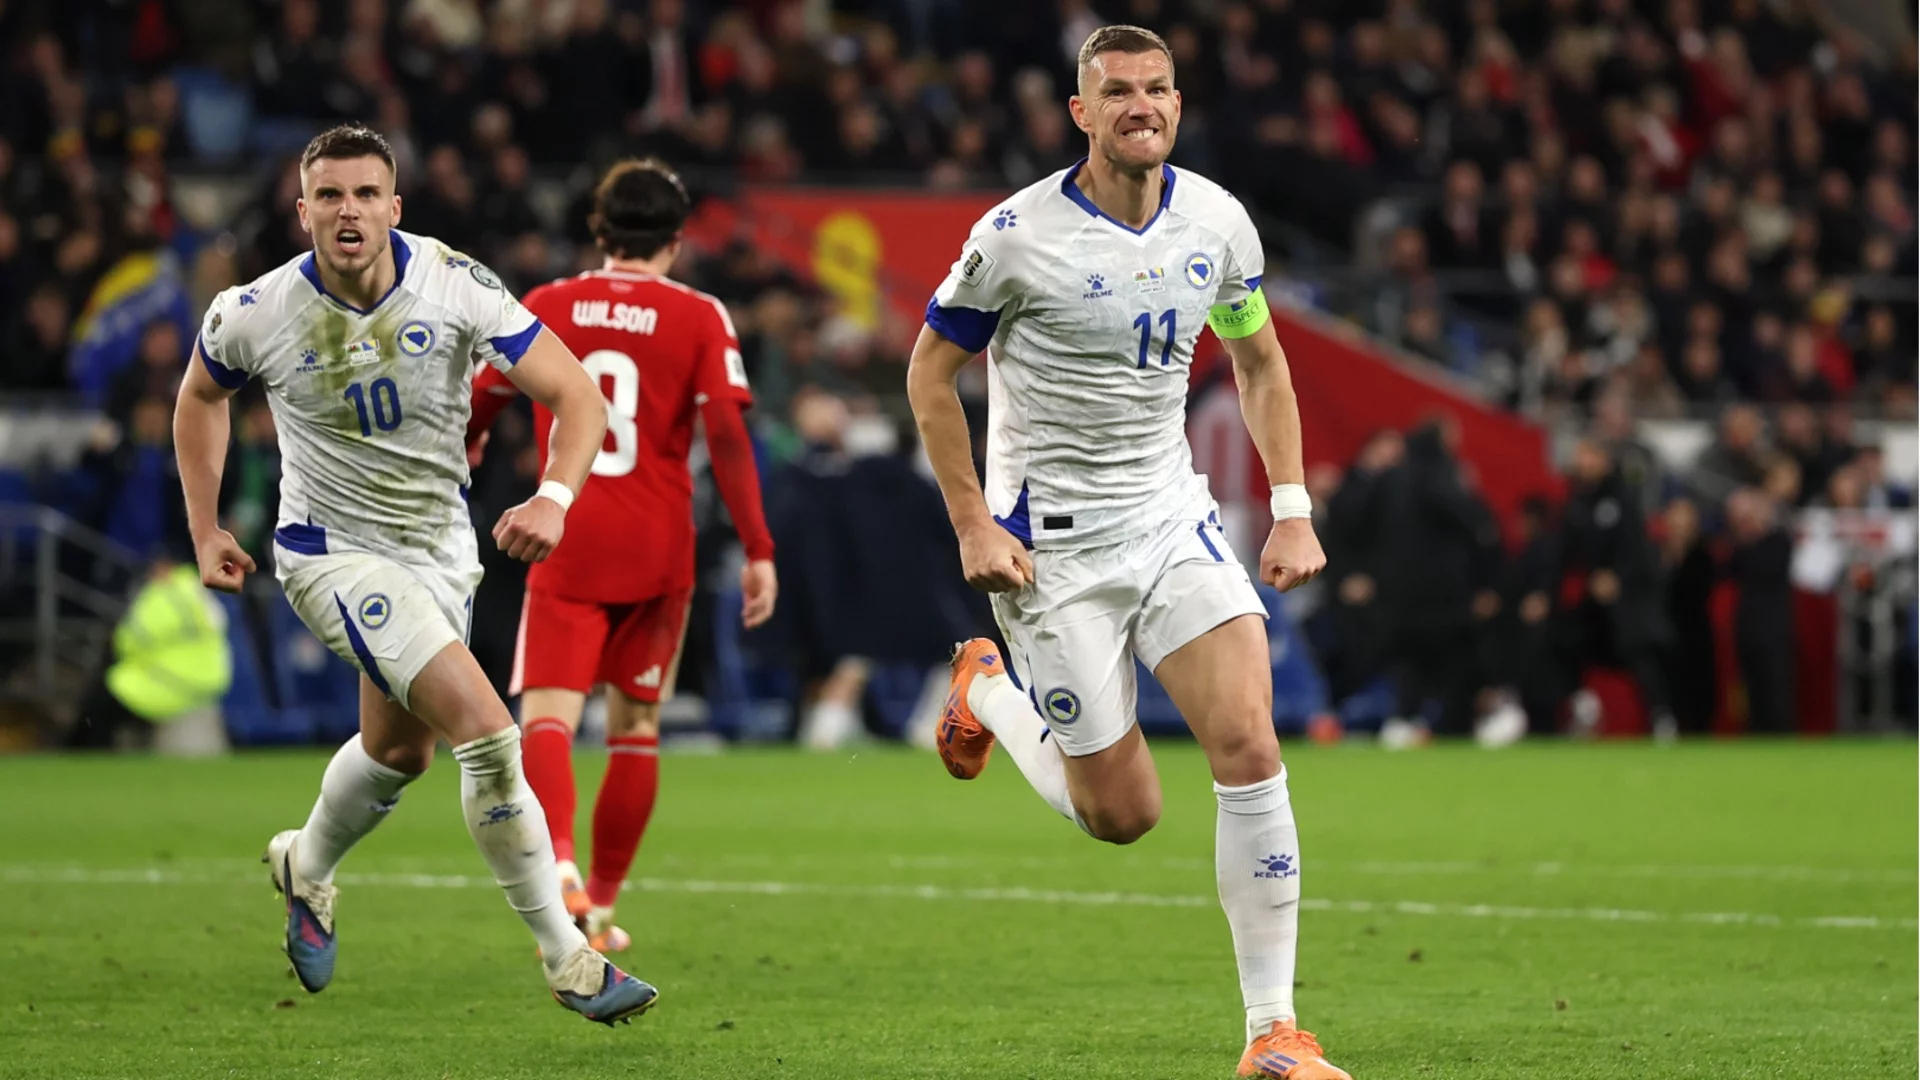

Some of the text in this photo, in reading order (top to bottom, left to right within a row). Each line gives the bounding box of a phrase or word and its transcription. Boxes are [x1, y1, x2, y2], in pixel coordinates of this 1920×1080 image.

[1082, 289, 1113, 299] KELME
[1223, 302, 1260, 325] RESPECT
[1132, 308, 1177, 369] 11
[295, 364, 325, 373] KELME
[343, 376, 401, 437] 10
[583, 350, 639, 476] 8
[1253, 868, 1298, 879] KELME
